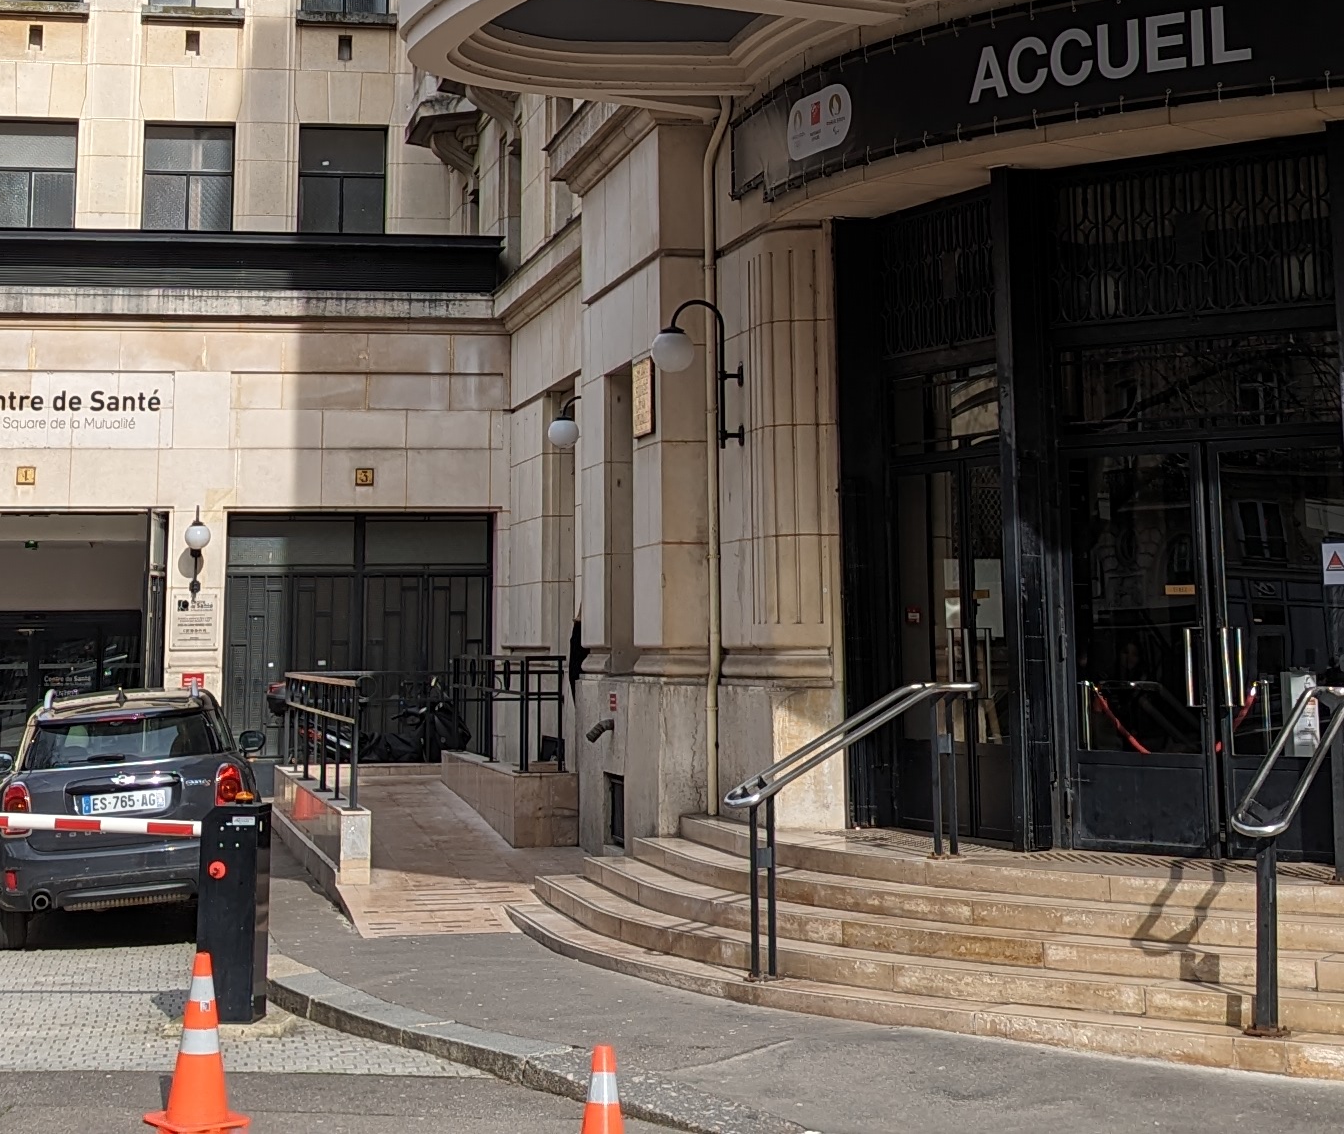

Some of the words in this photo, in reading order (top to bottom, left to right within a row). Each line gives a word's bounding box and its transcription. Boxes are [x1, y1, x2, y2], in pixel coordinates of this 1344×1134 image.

[968, 5, 1253, 105] ACCUEIL
[52, 390, 82, 412] de
[89, 388, 161, 412] Santé
[2, 416, 47, 432] Square
[50, 417, 66, 429] de
[69, 417, 80, 429] la
[84, 417, 136, 430] Mutualité
[359, 470, 369, 483] 3
[92, 792, 156, 812] ES-765-AG
